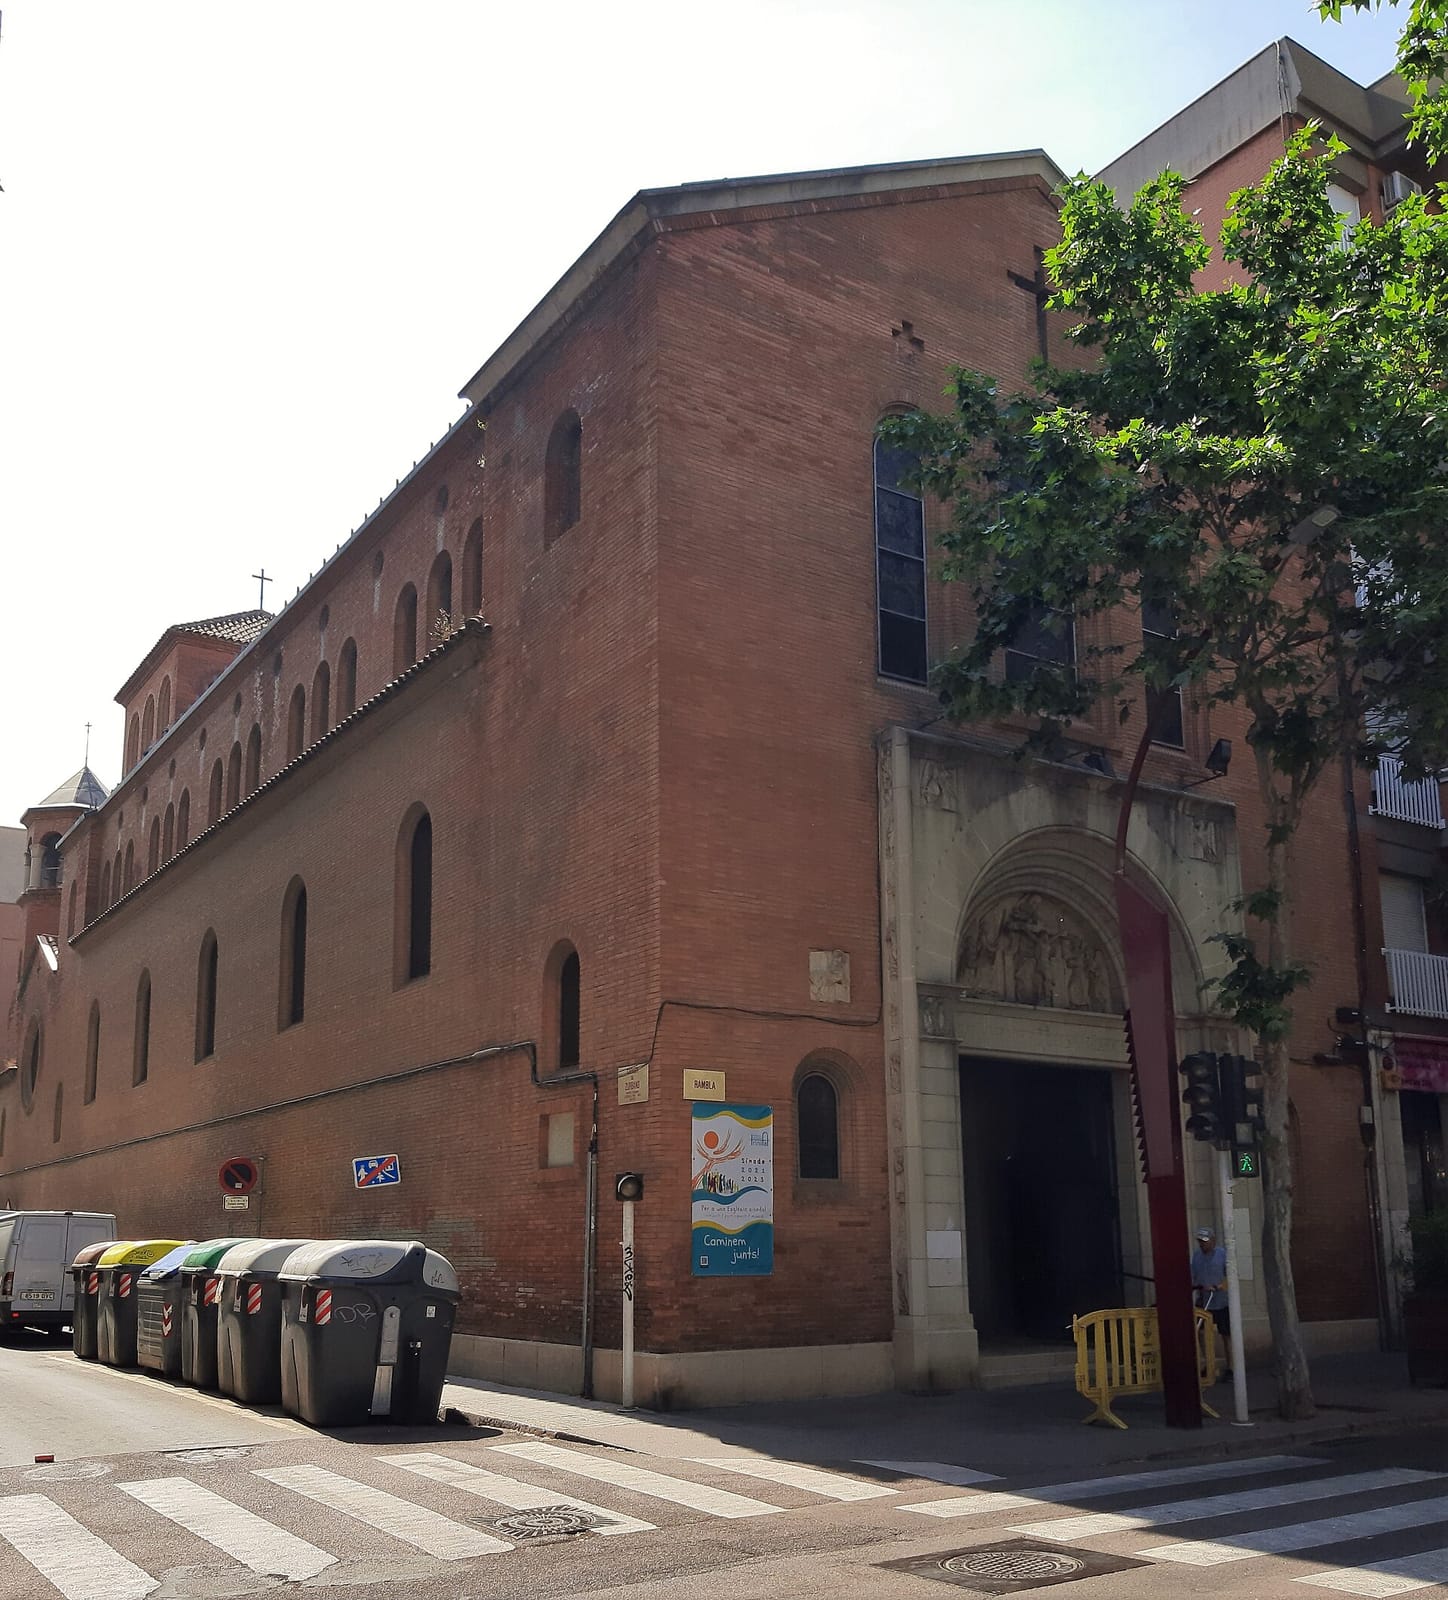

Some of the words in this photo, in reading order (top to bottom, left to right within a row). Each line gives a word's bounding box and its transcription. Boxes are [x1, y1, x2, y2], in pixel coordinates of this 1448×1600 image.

[694, 1080, 716, 1090] RAMBLA
[704, 1234, 747, 1247] Caminem
[731, 1247, 760, 1265] junts!
